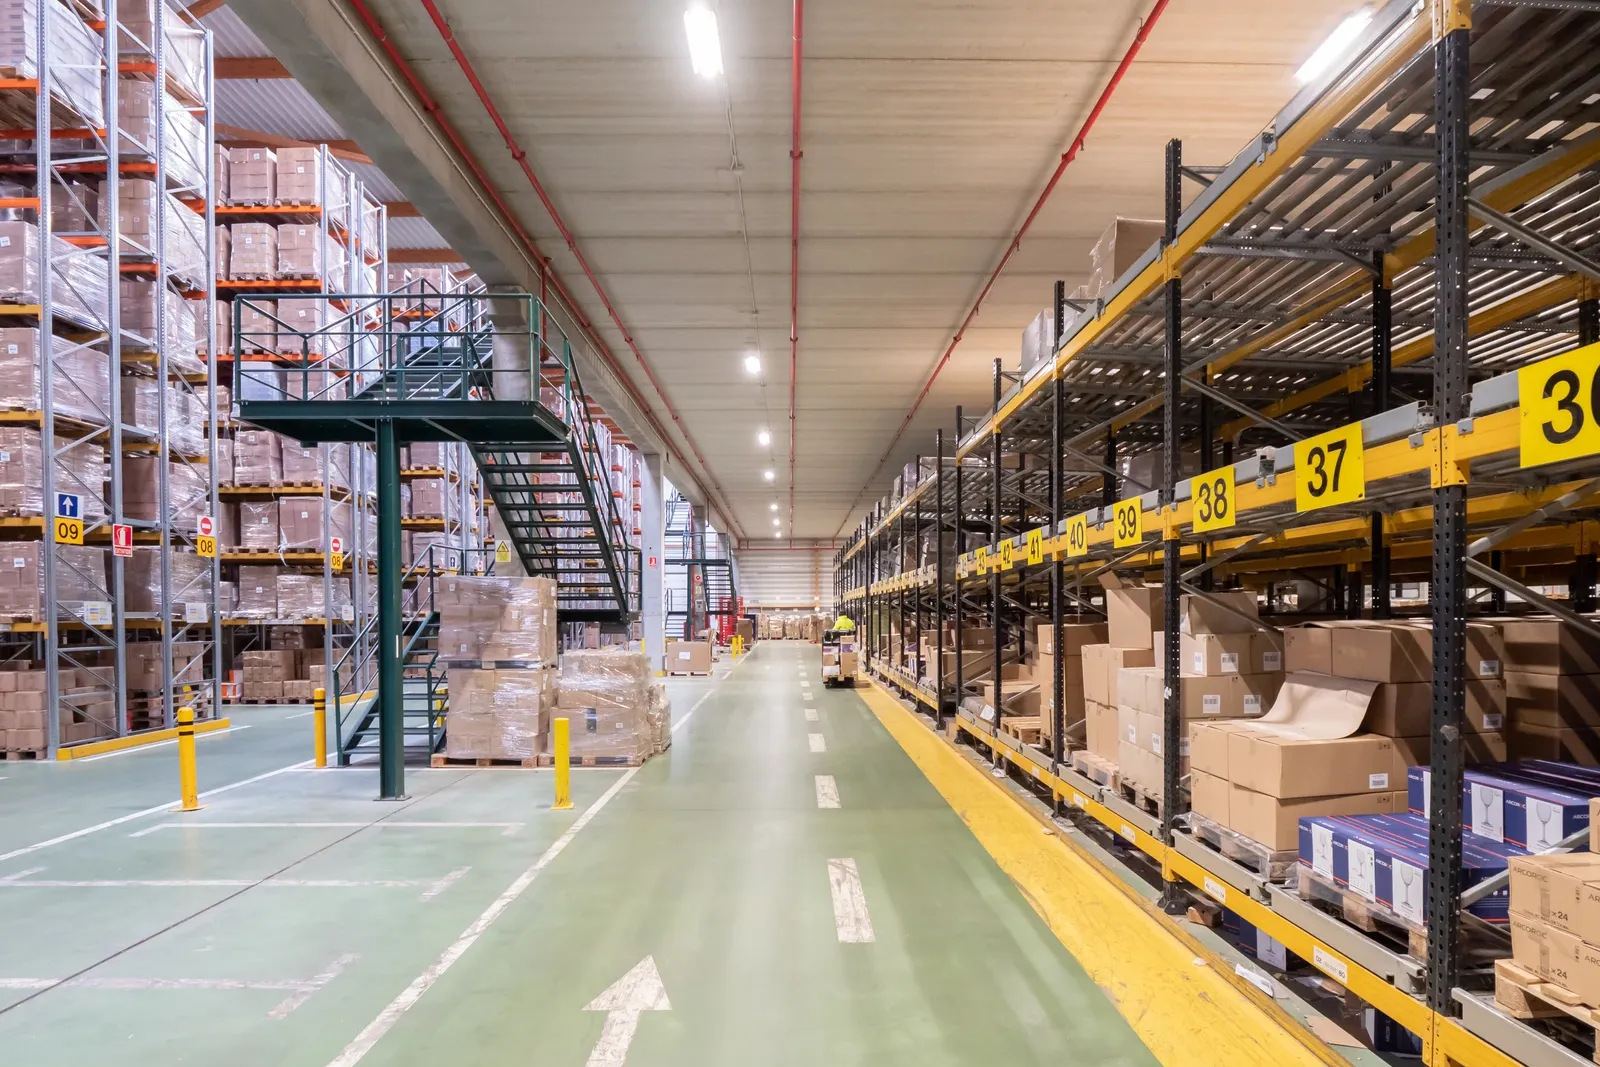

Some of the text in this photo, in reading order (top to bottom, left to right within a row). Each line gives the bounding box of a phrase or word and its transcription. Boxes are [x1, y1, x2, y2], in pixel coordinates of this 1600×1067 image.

[1307, 439, 1348, 498] 37
[1199, 478, 1228, 523] 38
[58, 522, 79, 540] 09
[1118, 505, 1137, 541] 39
[1070, 521, 1084, 550] 40
[200, 540, 213, 554] 08
[1003, 543, 1011, 564] 42
[1030, 535, 1040, 560] 41
[332, 555, 341, 568] 08
[1513, 866, 1548, 883] ARCOROC
[1513, 920, 1548, 940] ARCOROC
